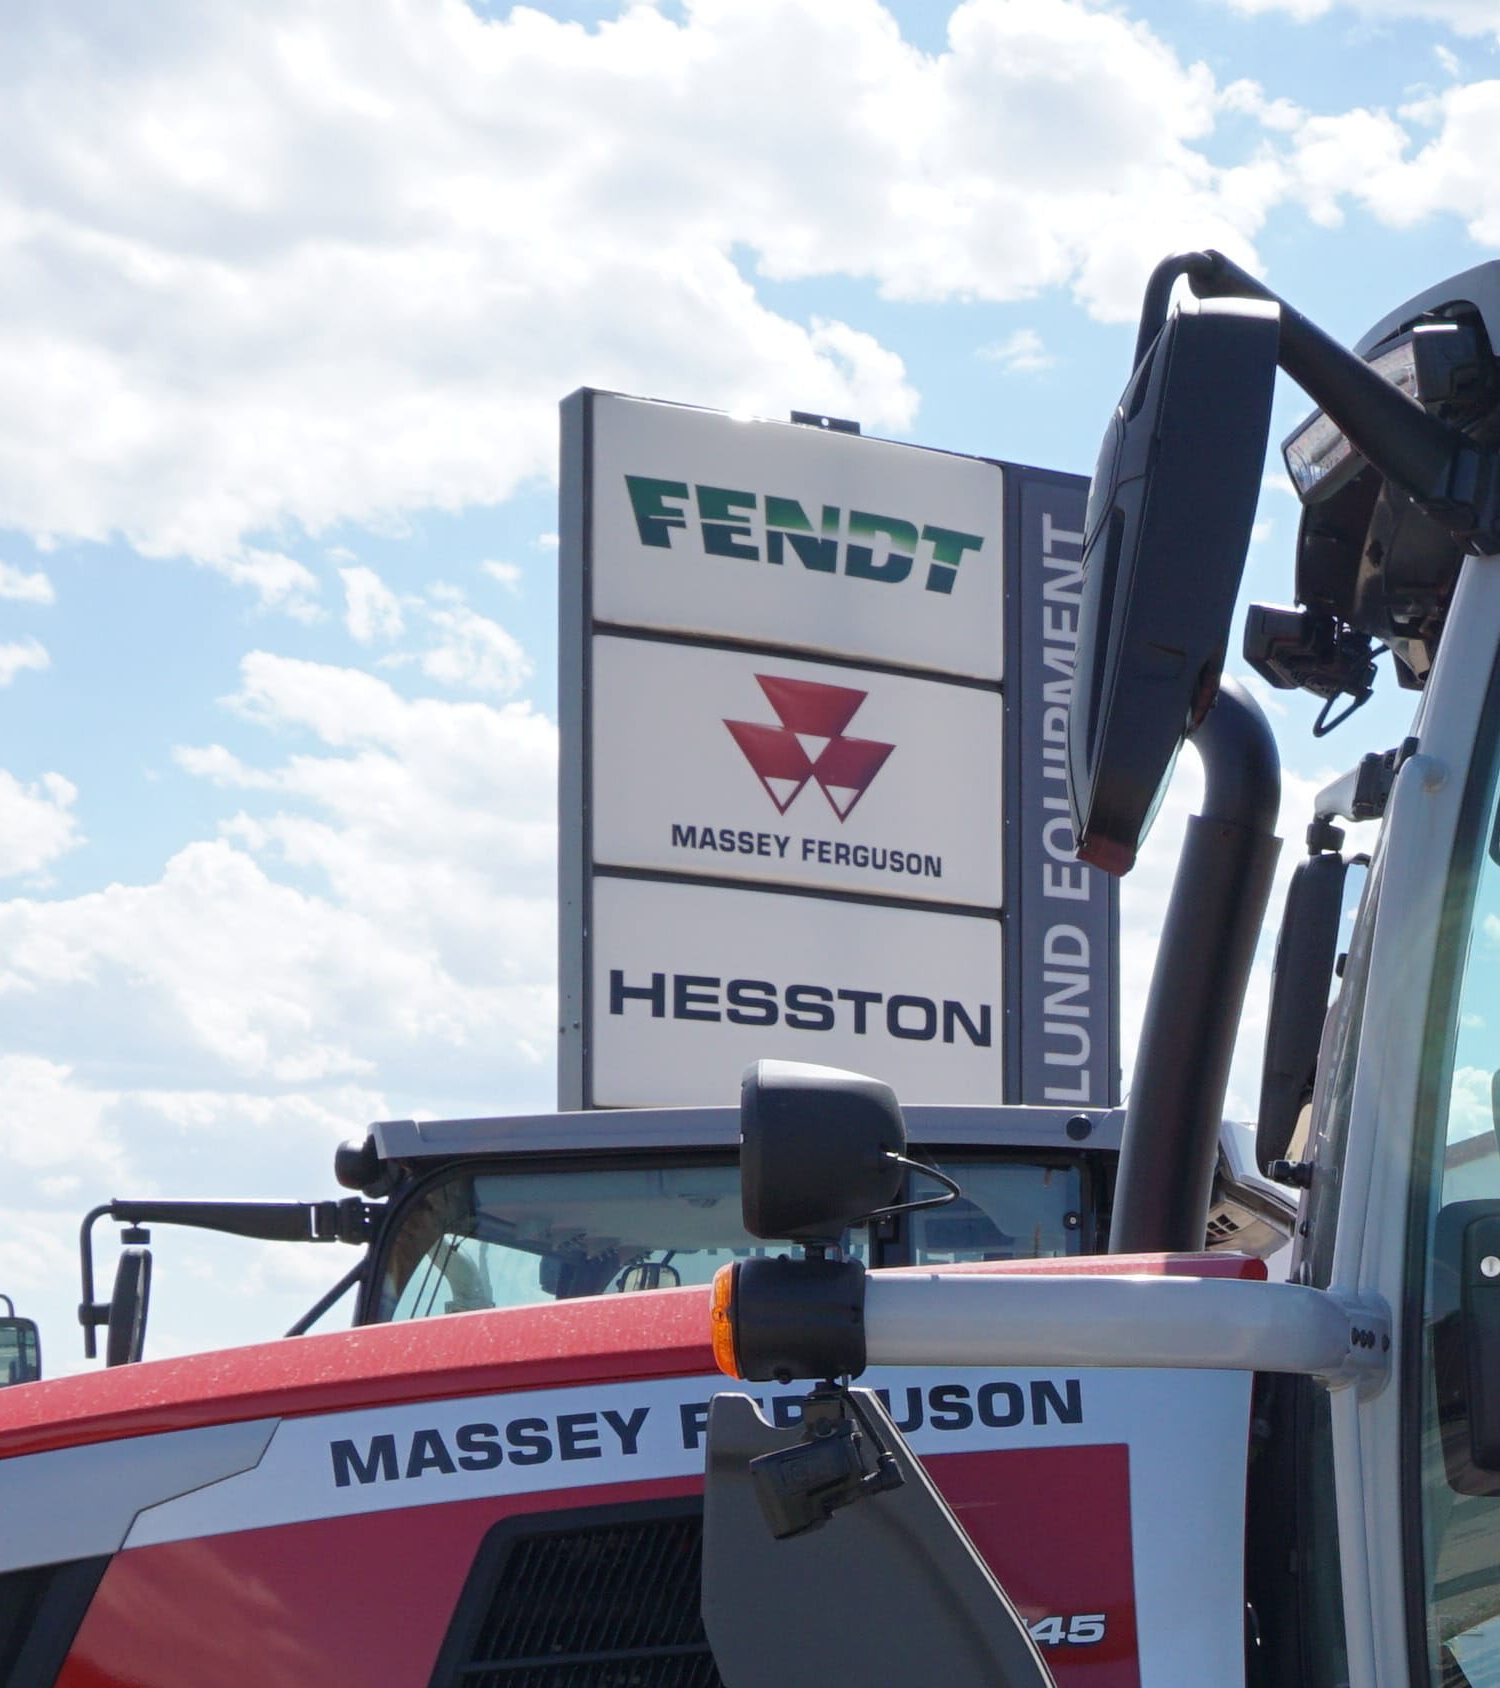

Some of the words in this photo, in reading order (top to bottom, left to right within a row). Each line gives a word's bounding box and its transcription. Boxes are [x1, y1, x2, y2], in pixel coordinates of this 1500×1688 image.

[624, 474, 985, 595] FENDT
[671, 824, 790, 861] MASSEY
[801, 837, 943, 879] FERGUSON
[609, 968, 993, 1048] HESSTON
[329, 1406, 652, 1488] MASSEY
[680, 1378, 1084, 1450] FUSON
[1021, 1613, 1106, 1645] 45
